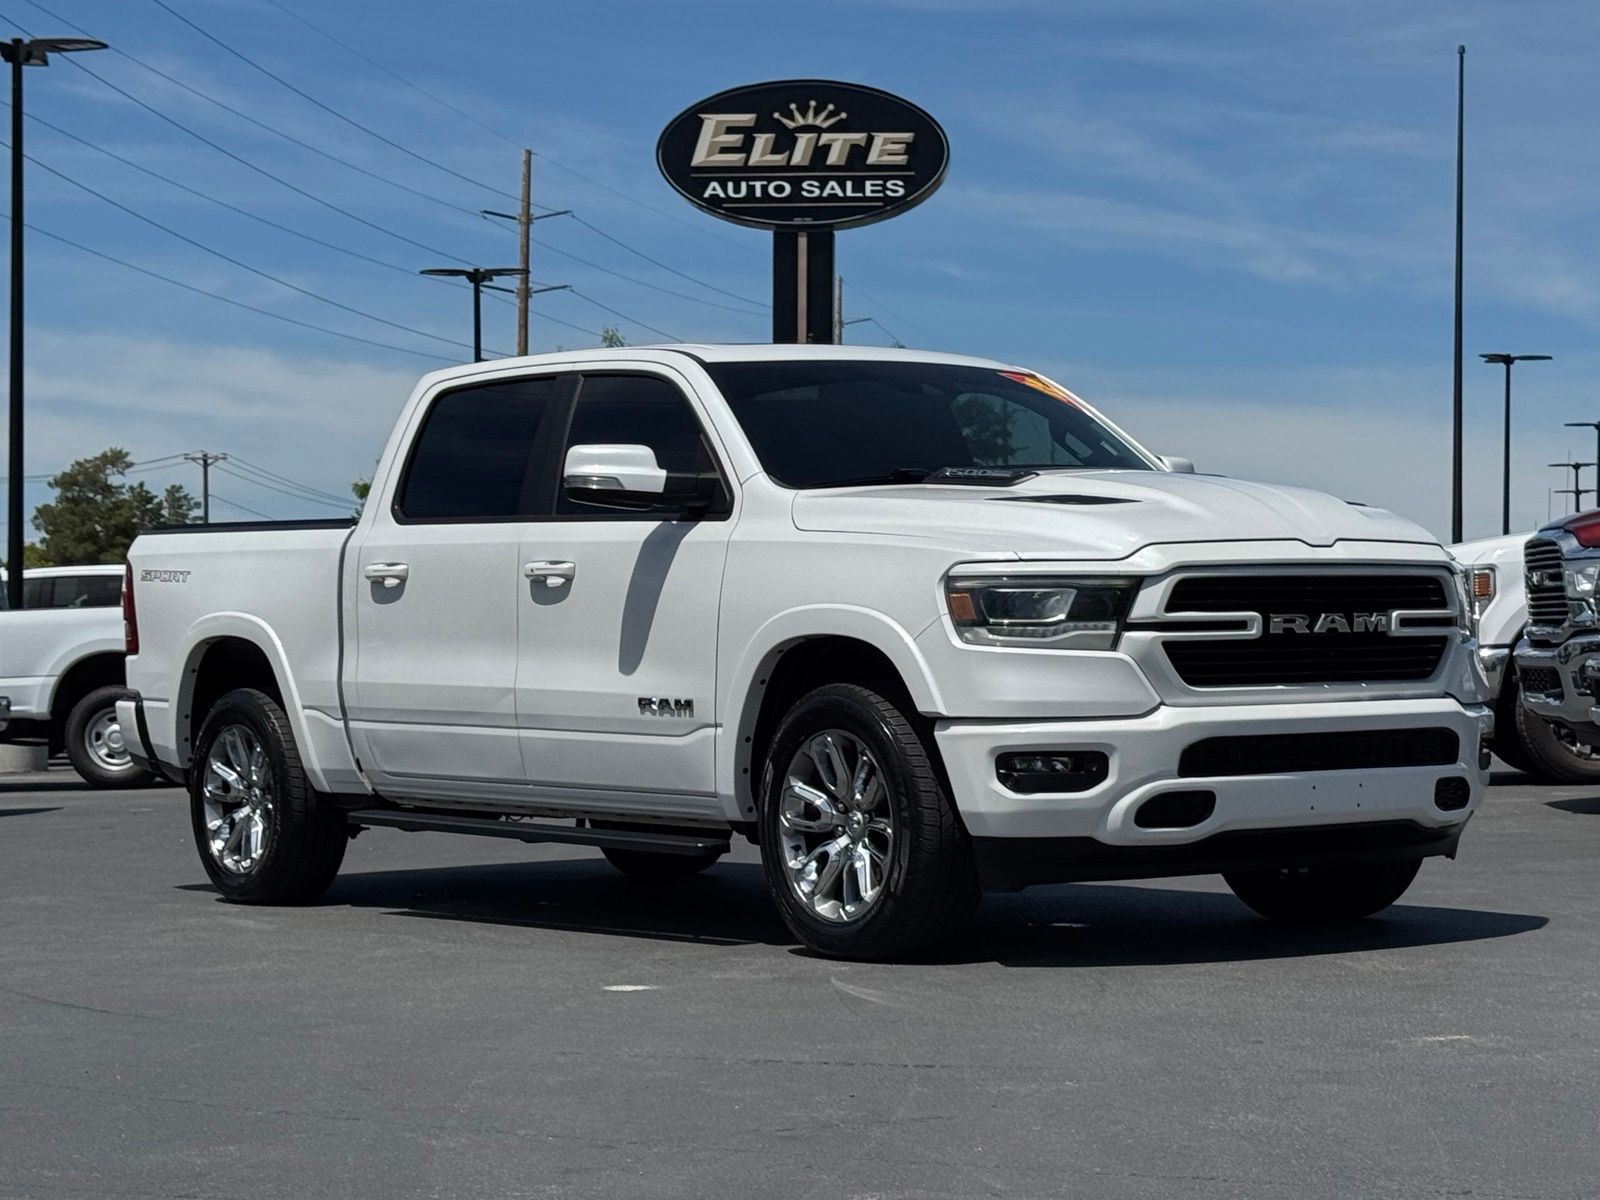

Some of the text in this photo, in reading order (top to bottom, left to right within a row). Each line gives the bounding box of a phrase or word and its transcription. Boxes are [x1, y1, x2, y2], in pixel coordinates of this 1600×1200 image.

[690, 113, 915, 167] ELITE
[703, 179, 906, 198] AUTO SALES
[141, 569, 191, 583] SPORT
[1269, 612, 1388, 634] RAM
[638, 697, 694, 718] RAM
